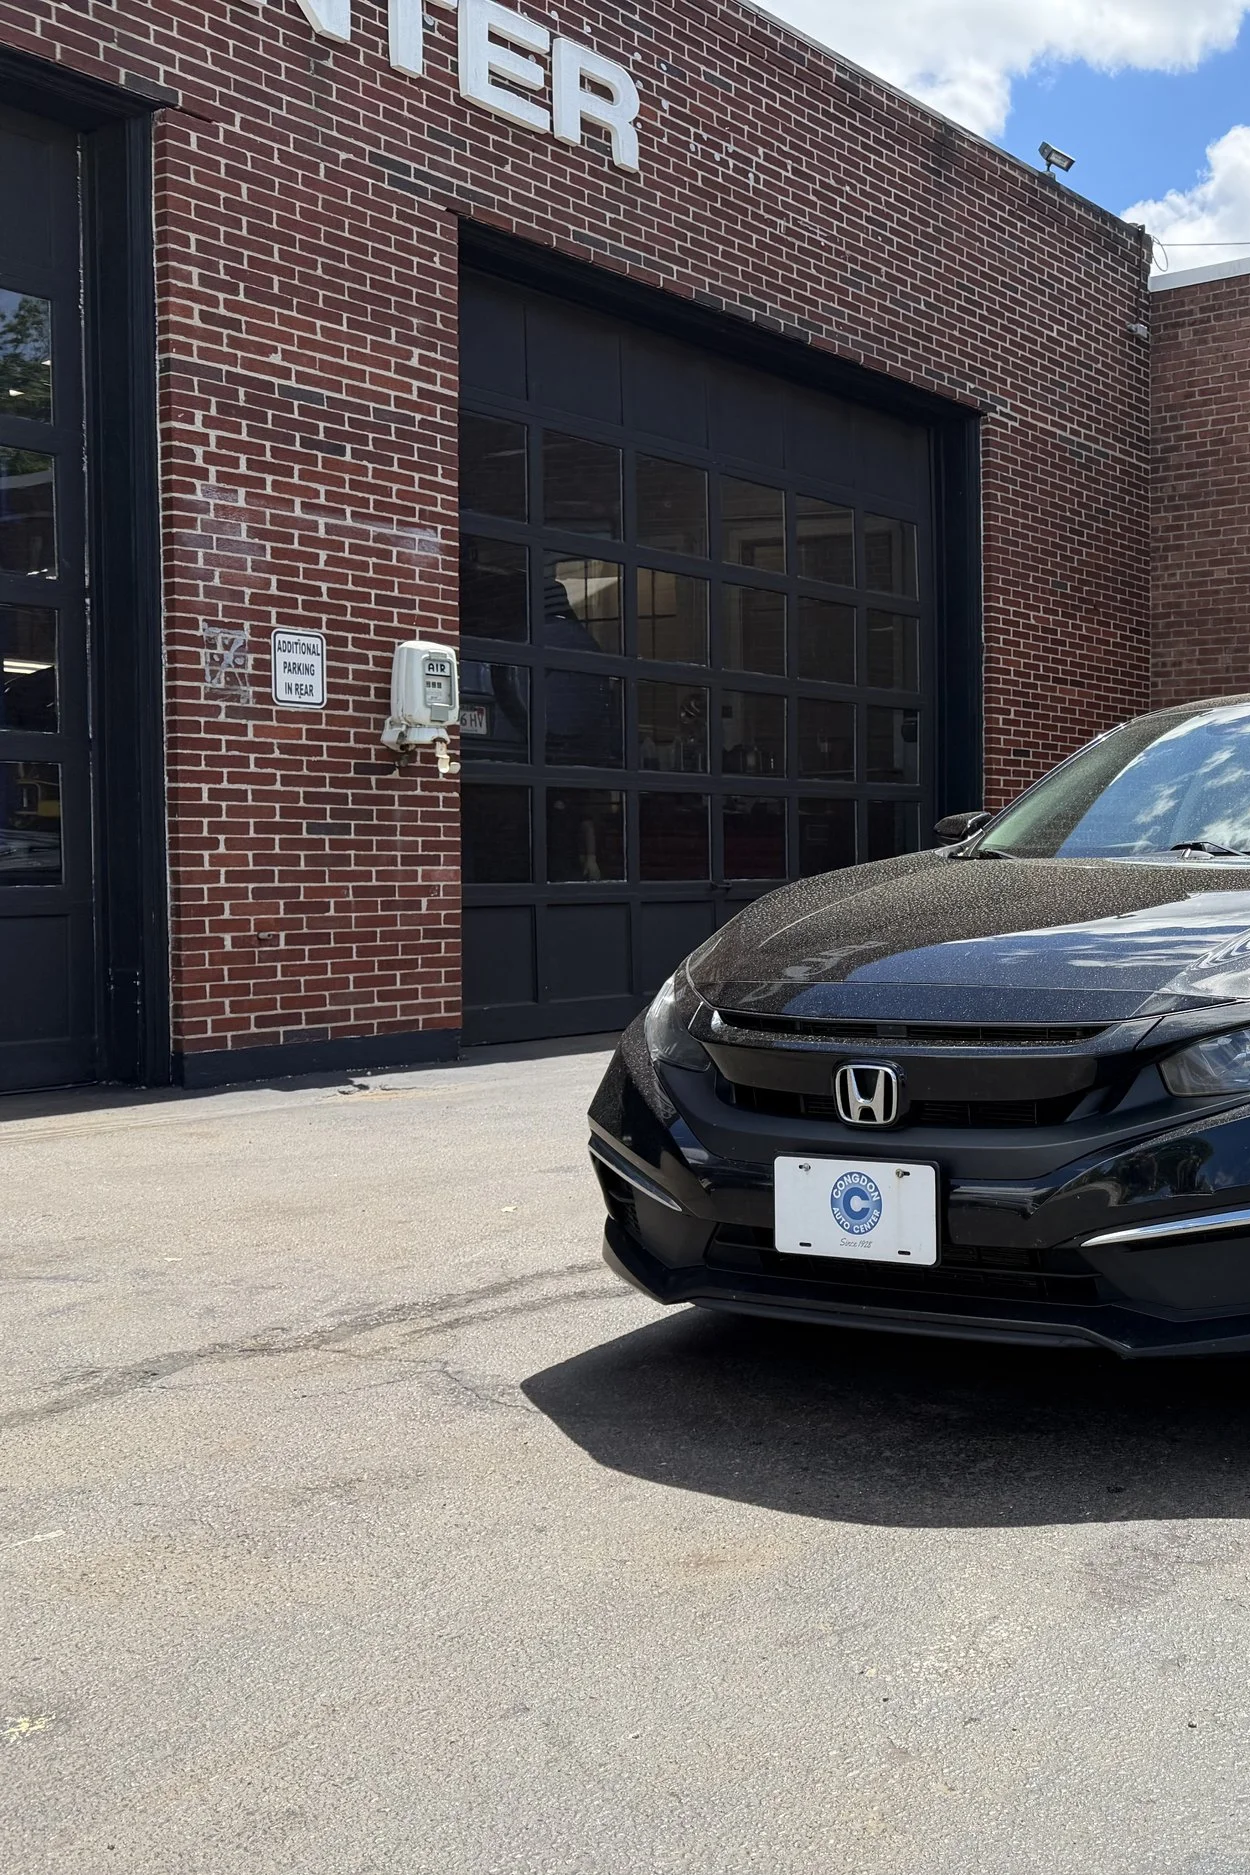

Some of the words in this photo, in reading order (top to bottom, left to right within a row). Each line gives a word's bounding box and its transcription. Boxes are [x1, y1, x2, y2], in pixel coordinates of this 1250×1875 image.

[277, 639, 321, 657] ADDITIONAL
[283, 661, 315, 676] PARKING
[428, 662, 446, 673] AIR
[285, 682, 293, 695] IN
[295, 683, 314, 697] REAR
[833, 1173, 880, 1201] CONGDON
[833, 1207, 850, 1230] AUTO
[853, 1209, 880, 1233] CENTER
[839, 1237, 857, 1247] Since
